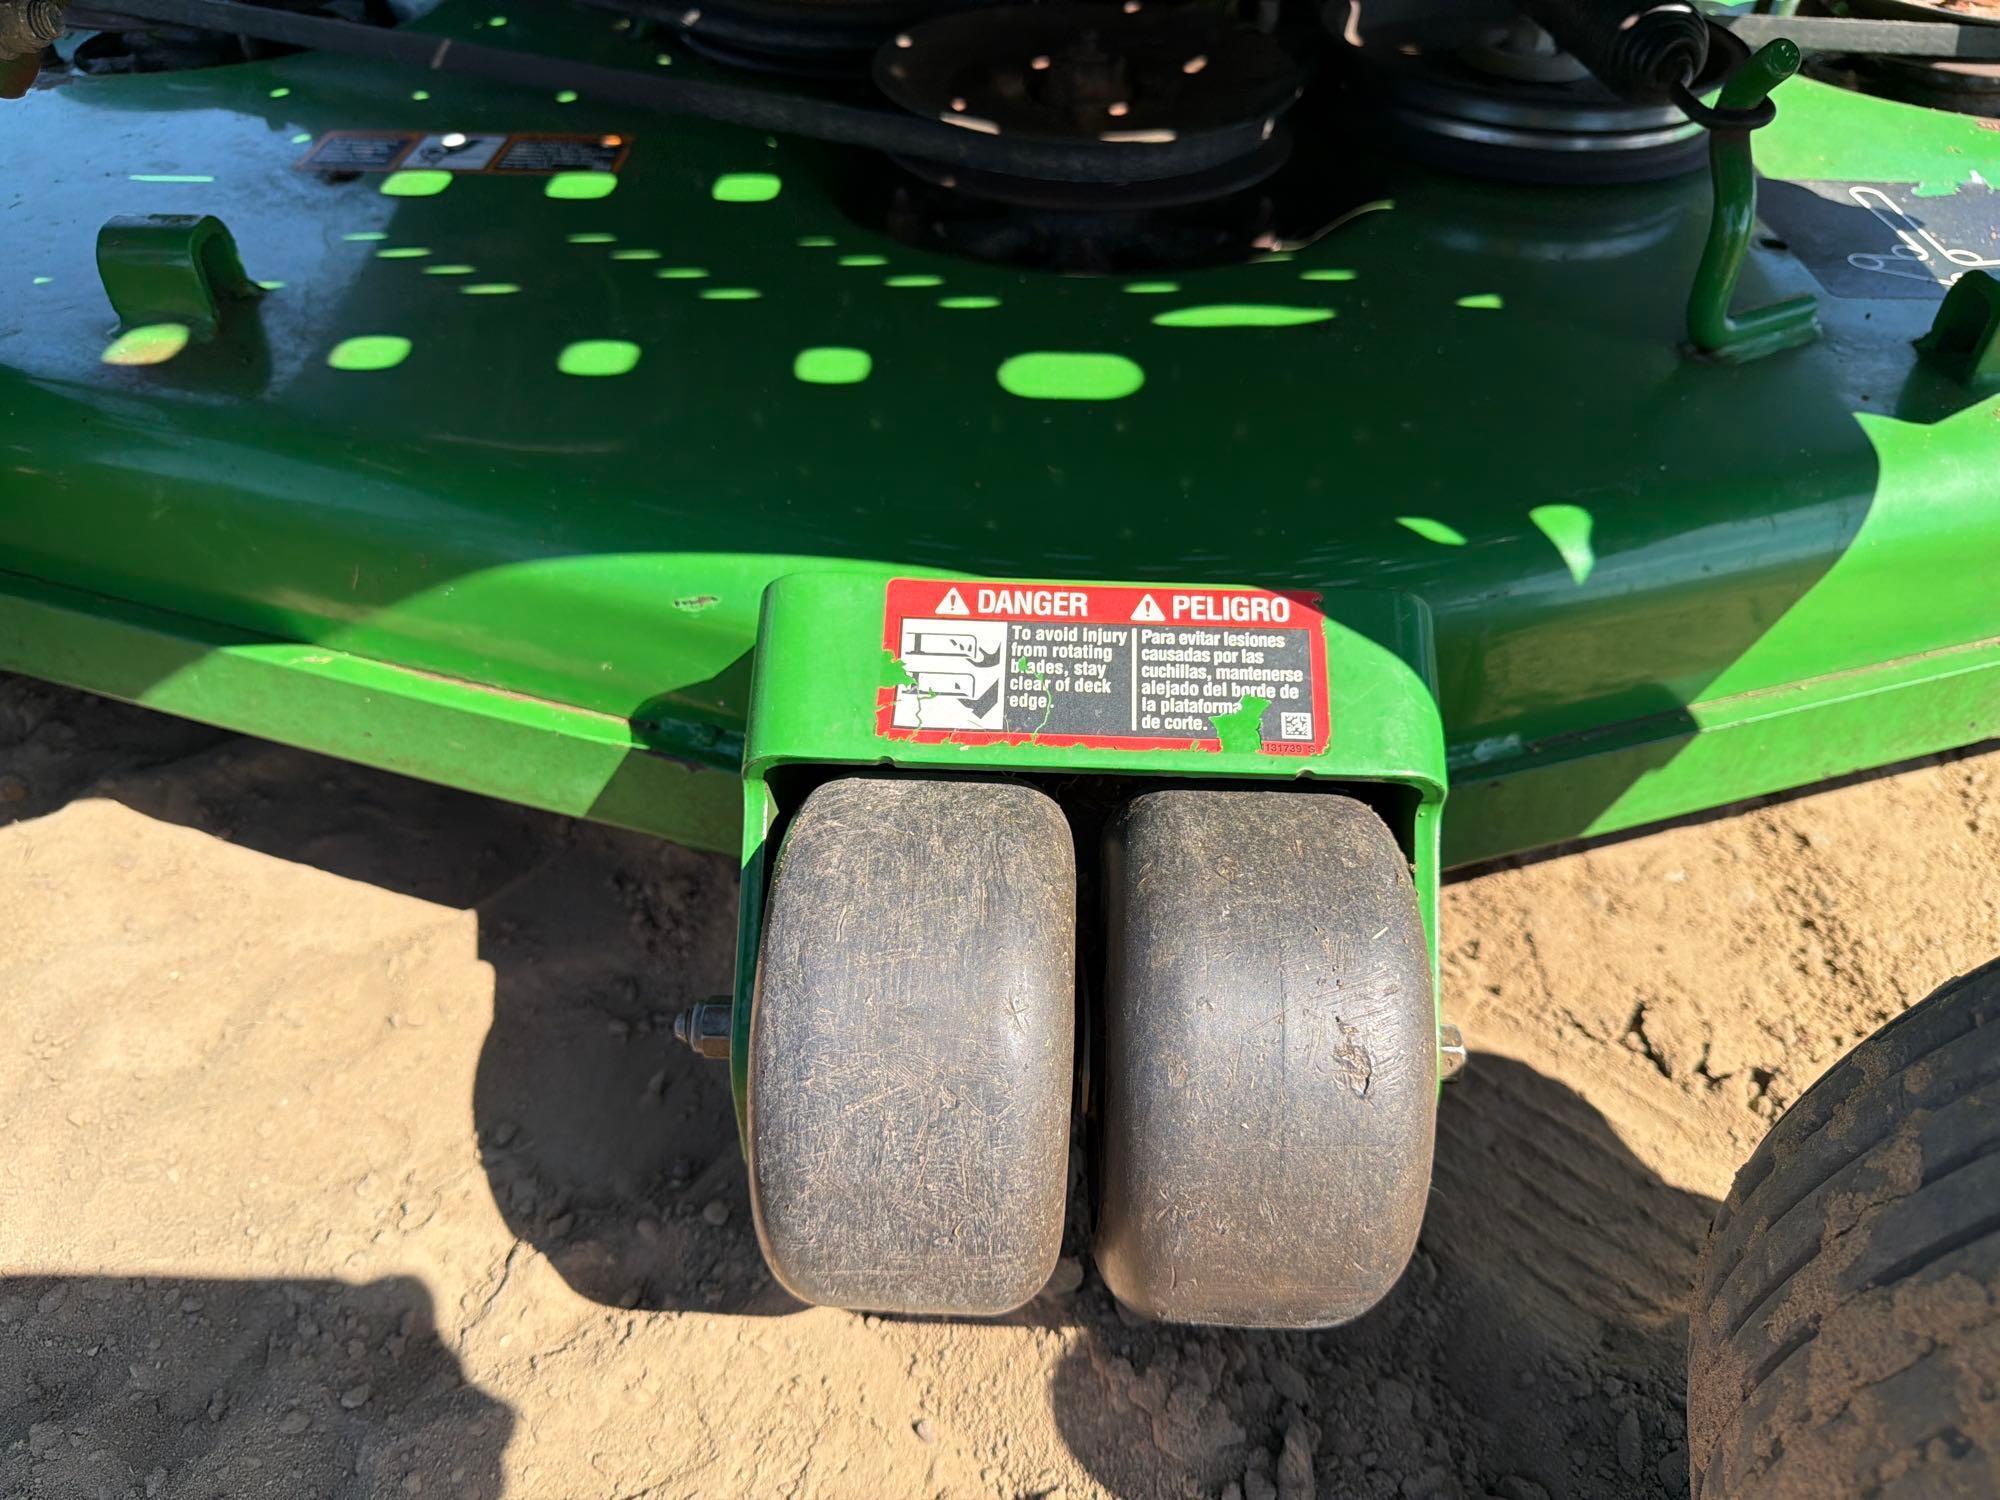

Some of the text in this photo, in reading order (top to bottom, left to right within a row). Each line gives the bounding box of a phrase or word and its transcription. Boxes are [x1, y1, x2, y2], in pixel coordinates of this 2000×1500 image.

[977, 589, 1088, 616] DANGER
[1172, 595, 1290, 622] PELIGRO
[1011, 625, 1128, 646] To avoid injury
[1141, 629, 1286, 648] Para evitar lesiones
[1011, 641, 1113, 662] from rotating
[1141, 647, 1264, 666] causadas por las
[1010, 658, 1107, 679] bades, stay
[1141, 663, 1303, 682] cuchillas, mantenerse
[1009, 675, 1112, 693] clear of deck
[1141, 679, 1299, 699] alejado del borde de
[1009, 692, 1054, 711] edge.
[1141, 696, 1156, 712] la
[1141, 714, 1208, 730] de corte.
